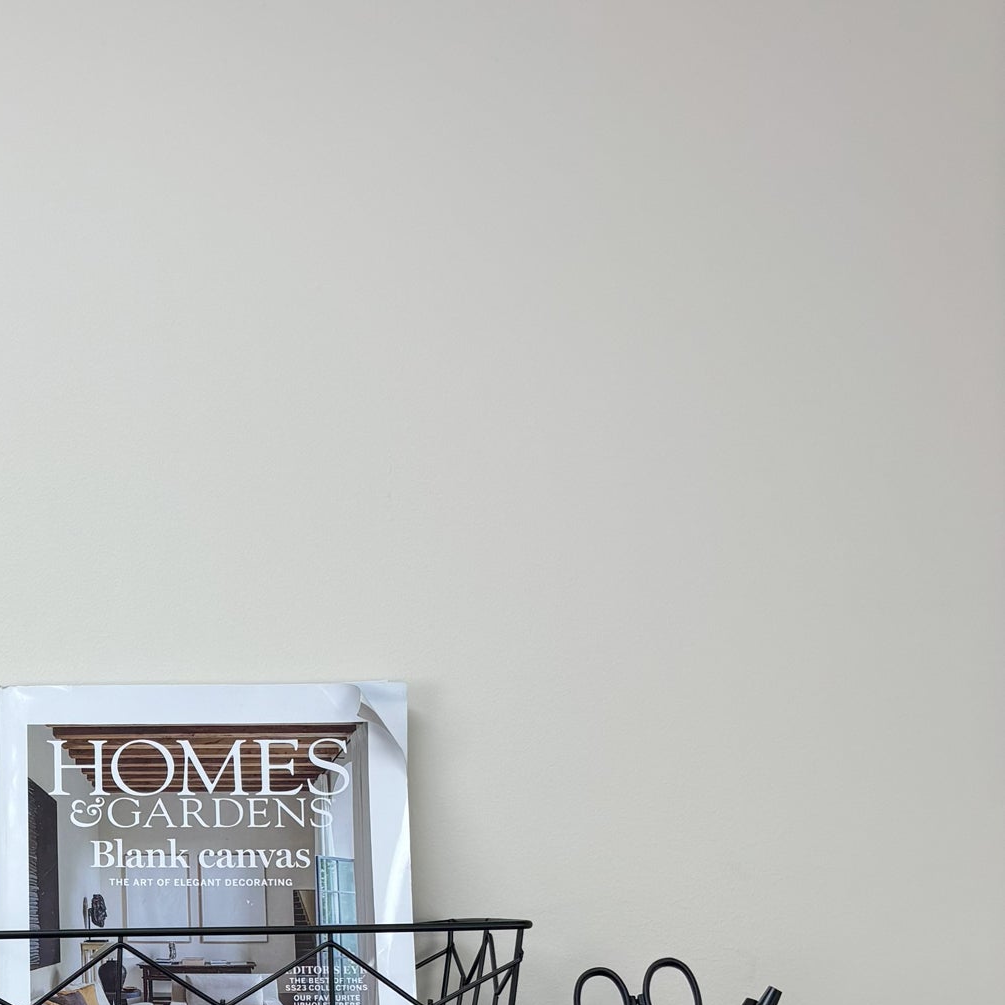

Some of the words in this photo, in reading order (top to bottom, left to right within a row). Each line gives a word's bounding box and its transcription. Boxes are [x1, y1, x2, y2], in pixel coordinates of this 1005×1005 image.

[47, 738, 350, 796] HOMES
[90, 839, 190, 869] Blank
[198, 847, 310, 869] canvas
[109, 878, 130, 887] THE
[133, 878, 154, 887] ART
[157, 878, 170, 887] OF
[174, 878, 222, 887] ELEGANT
[225, 878, 293, 887] DECORATING
